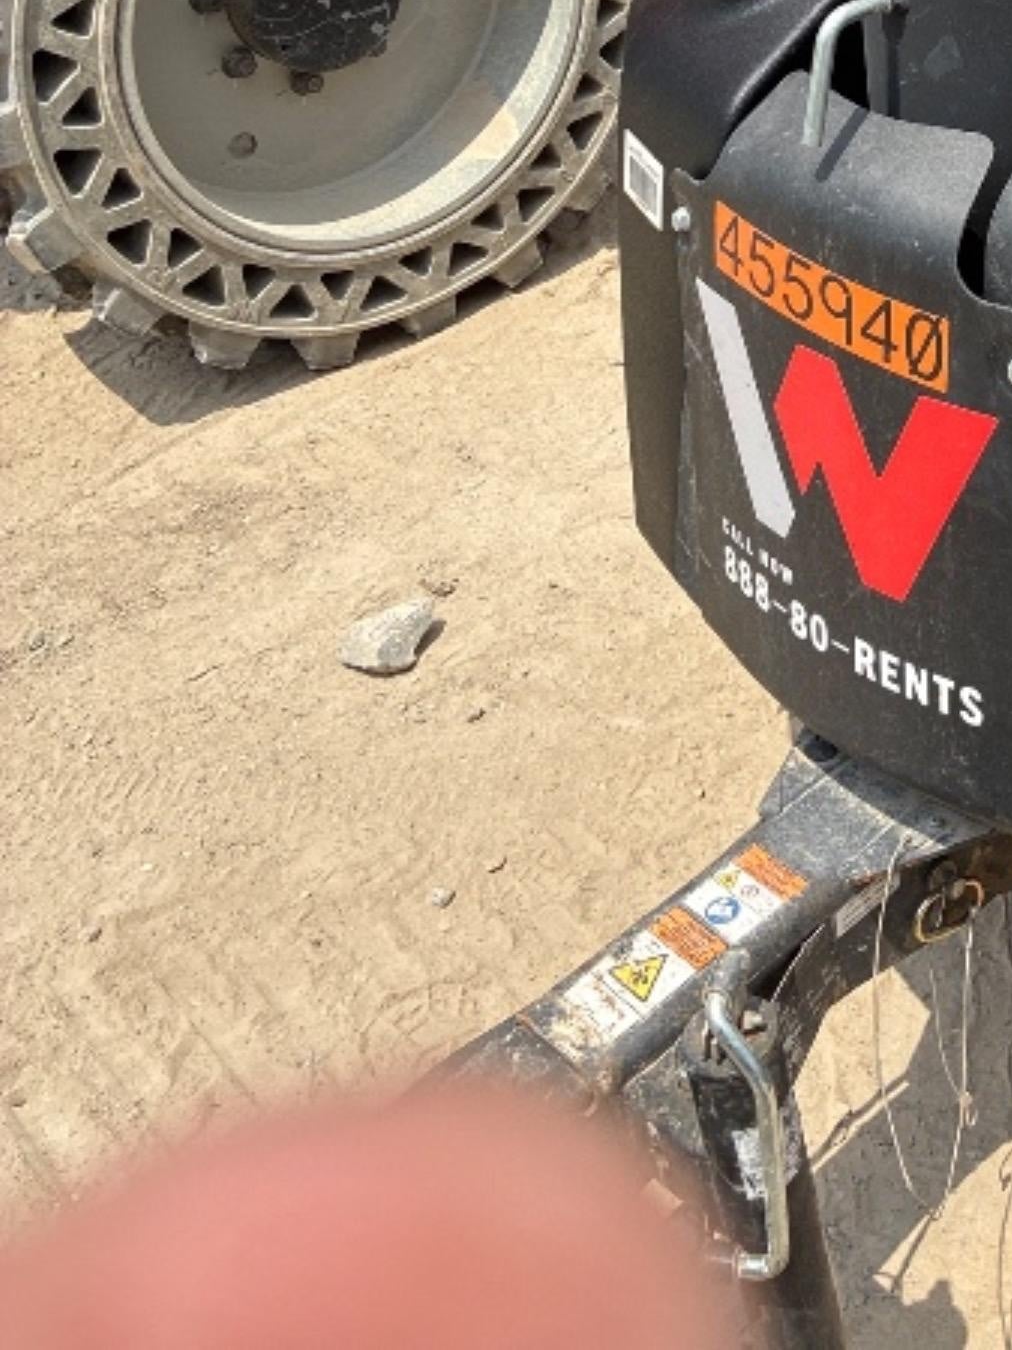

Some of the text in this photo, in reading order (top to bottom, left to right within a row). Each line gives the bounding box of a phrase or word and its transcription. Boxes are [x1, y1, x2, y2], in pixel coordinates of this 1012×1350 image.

[719, 214, 944, 382] 455940
[722, 515, 794, 587] CALL NOW
[723, 544, 986, 728] 888-80-RENTS
